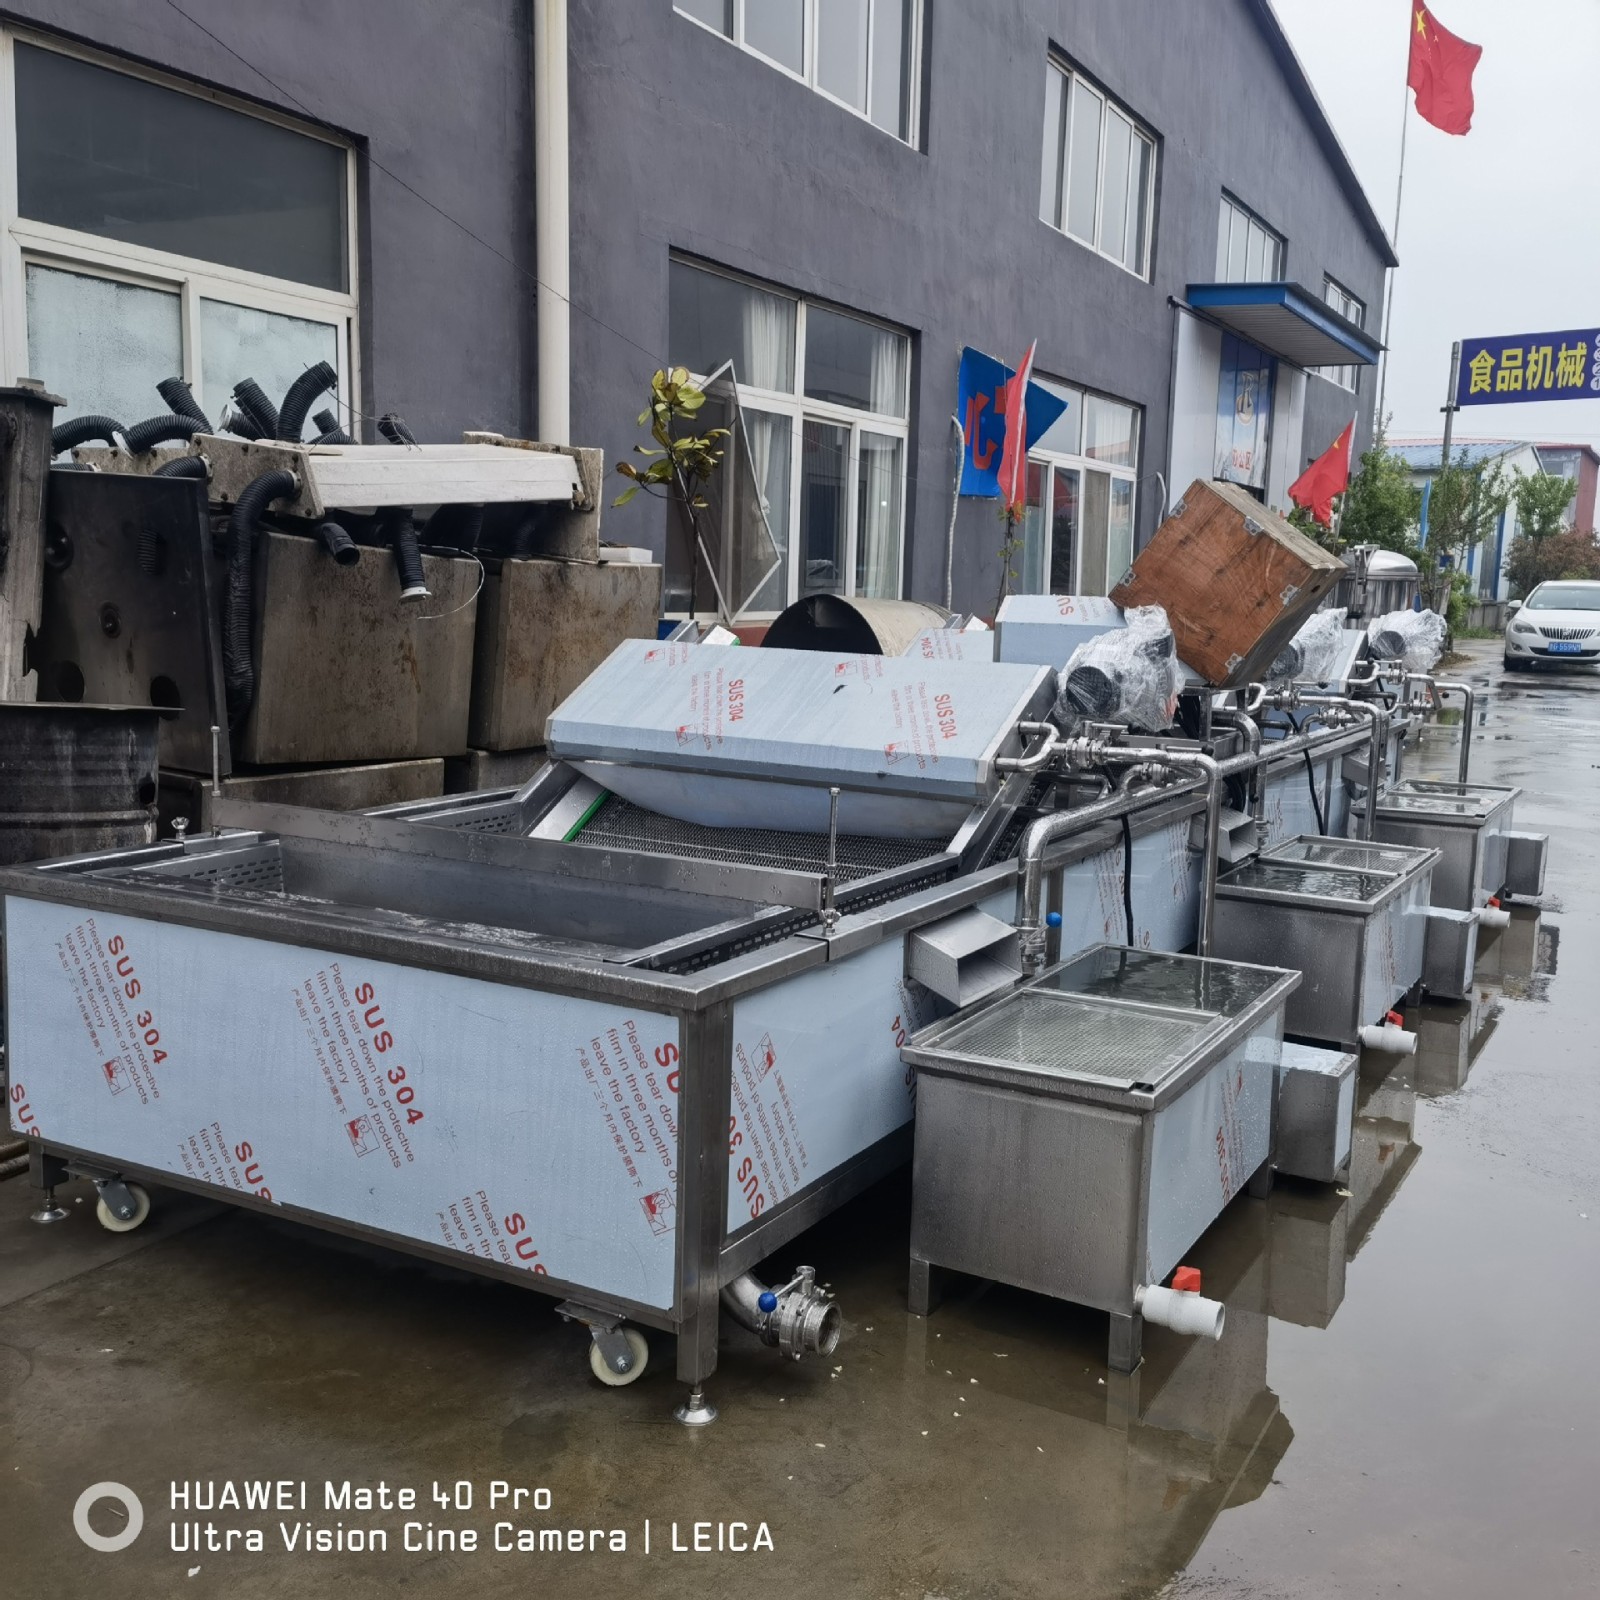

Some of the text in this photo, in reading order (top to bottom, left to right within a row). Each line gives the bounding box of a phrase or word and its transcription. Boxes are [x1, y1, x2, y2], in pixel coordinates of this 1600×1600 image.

[1469, 342, 1587, 394] 食品机械
[729, 679, 744, 721] SUS 304
[934, 694, 958, 739] SUS 304
[65, 933, 106, 1029] leave the factory
[108, 935, 168, 1064] SUS 304
[75, 925, 149, 1105] film in three months of products
[86, 918, 159, 1099] Please tear down the protective
[304, 978, 349, 1084] leave the factory
[316, 971, 402, 1169] film in three months of products
[330, 963, 414, 1163] Please tear down the protective
[355, 982, 424, 1125] SUS 304
[623, 1020, 649, 1070] Please
[645, 1072, 664, 1100] tear
[735, 1043, 757, 1091] products
[591, 1037, 646, 1153] leave the factory
[606, 1028, 622, 1056] film
[618, 1057, 629, 1071] in
[625, 1074, 646, 1111] three
[643, 1114, 672, 1167] months
[750, 1090, 760, 1104] of
[211, 1122, 231, 1164] Please
[743, 1111, 753, 1133] the
[756, 1102, 773, 1143] months
[770, 1101, 785, 1140] factory
[188, 1135, 205, 1168] leave
[199, 1128, 212, 1151] film
[209, 1152, 218, 1164] in
[750, 1129, 763, 1160] down
[770, 1141, 782, 1172] three
[737, 1156, 764, 1219] SUS
[760, 1160, 770, 1183] tear
[448, 1203, 468, 1240] leave
[462, 1196, 477, 1221] film
[473, 1224, 483, 1237] in
[476, 1190, 500, 1236] Please
